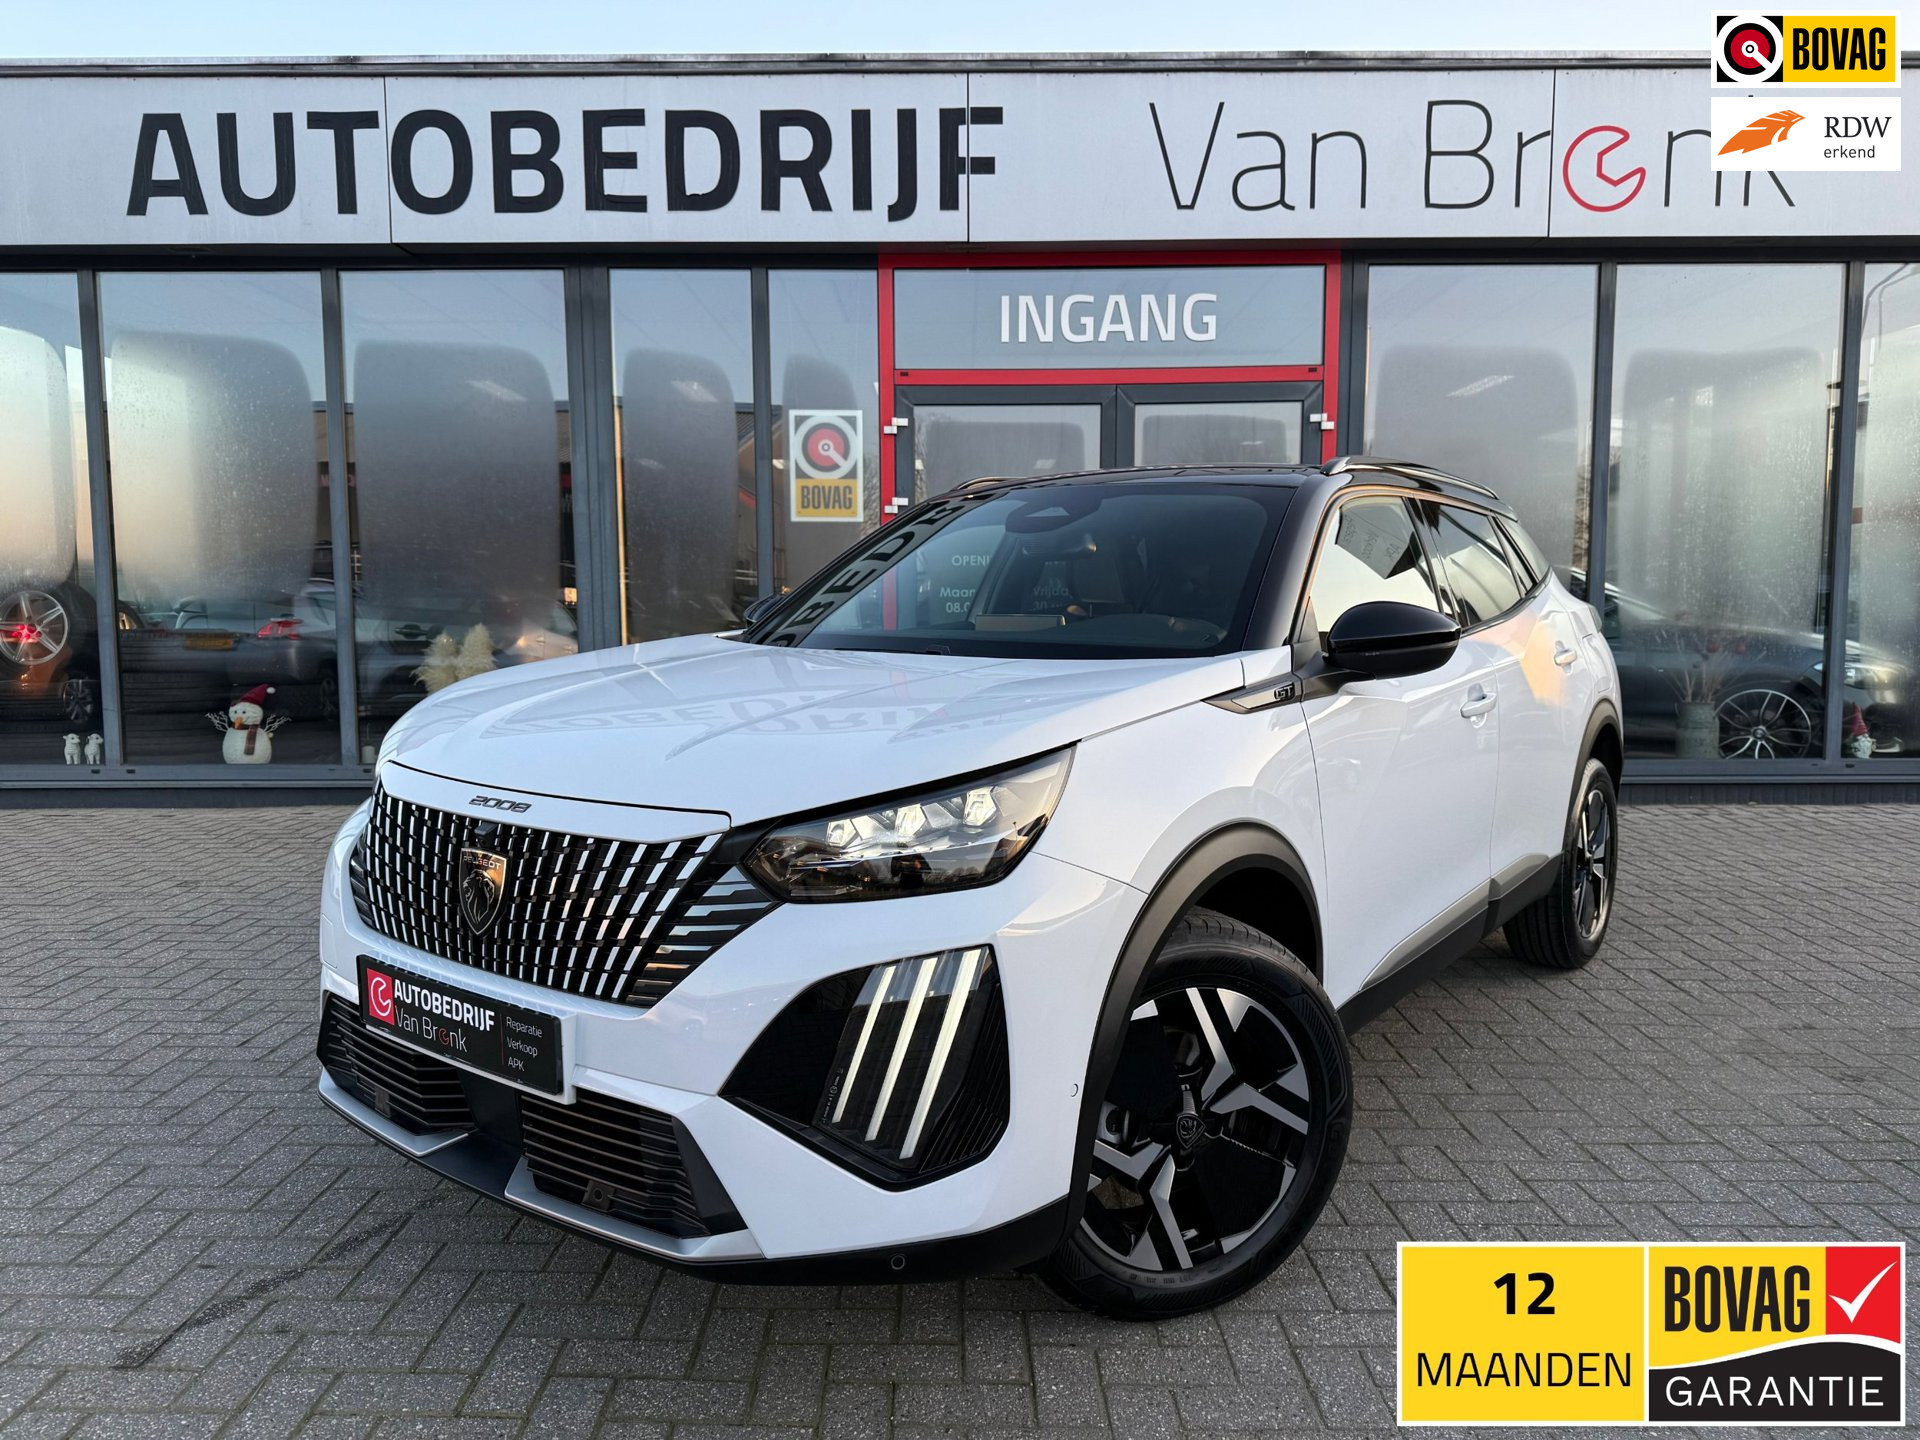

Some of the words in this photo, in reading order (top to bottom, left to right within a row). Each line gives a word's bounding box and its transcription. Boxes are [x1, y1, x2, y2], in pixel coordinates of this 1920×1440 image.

[127, 105, 1005, 222] AUTOBEDRIJF
[1149, 101, 1368, 212] Van
[1000, 292, 1219, 344] INGANG
[800, 485, 853, 510] BOVAG
[1274, 682, 1294, 700] GT
[469, 795, 532, 814] 2008
[463, 855, 502, 870] PEUGEOT
[394, 979, 495, 1032] AUTOBEDRIJF
[394, 1004, 420, 1035] Van
[506, 1016, 543, 1038] Reparatie
[506, 1036, 538, 1057] Verkoop
[507, 1058, 525, 1072] APK
